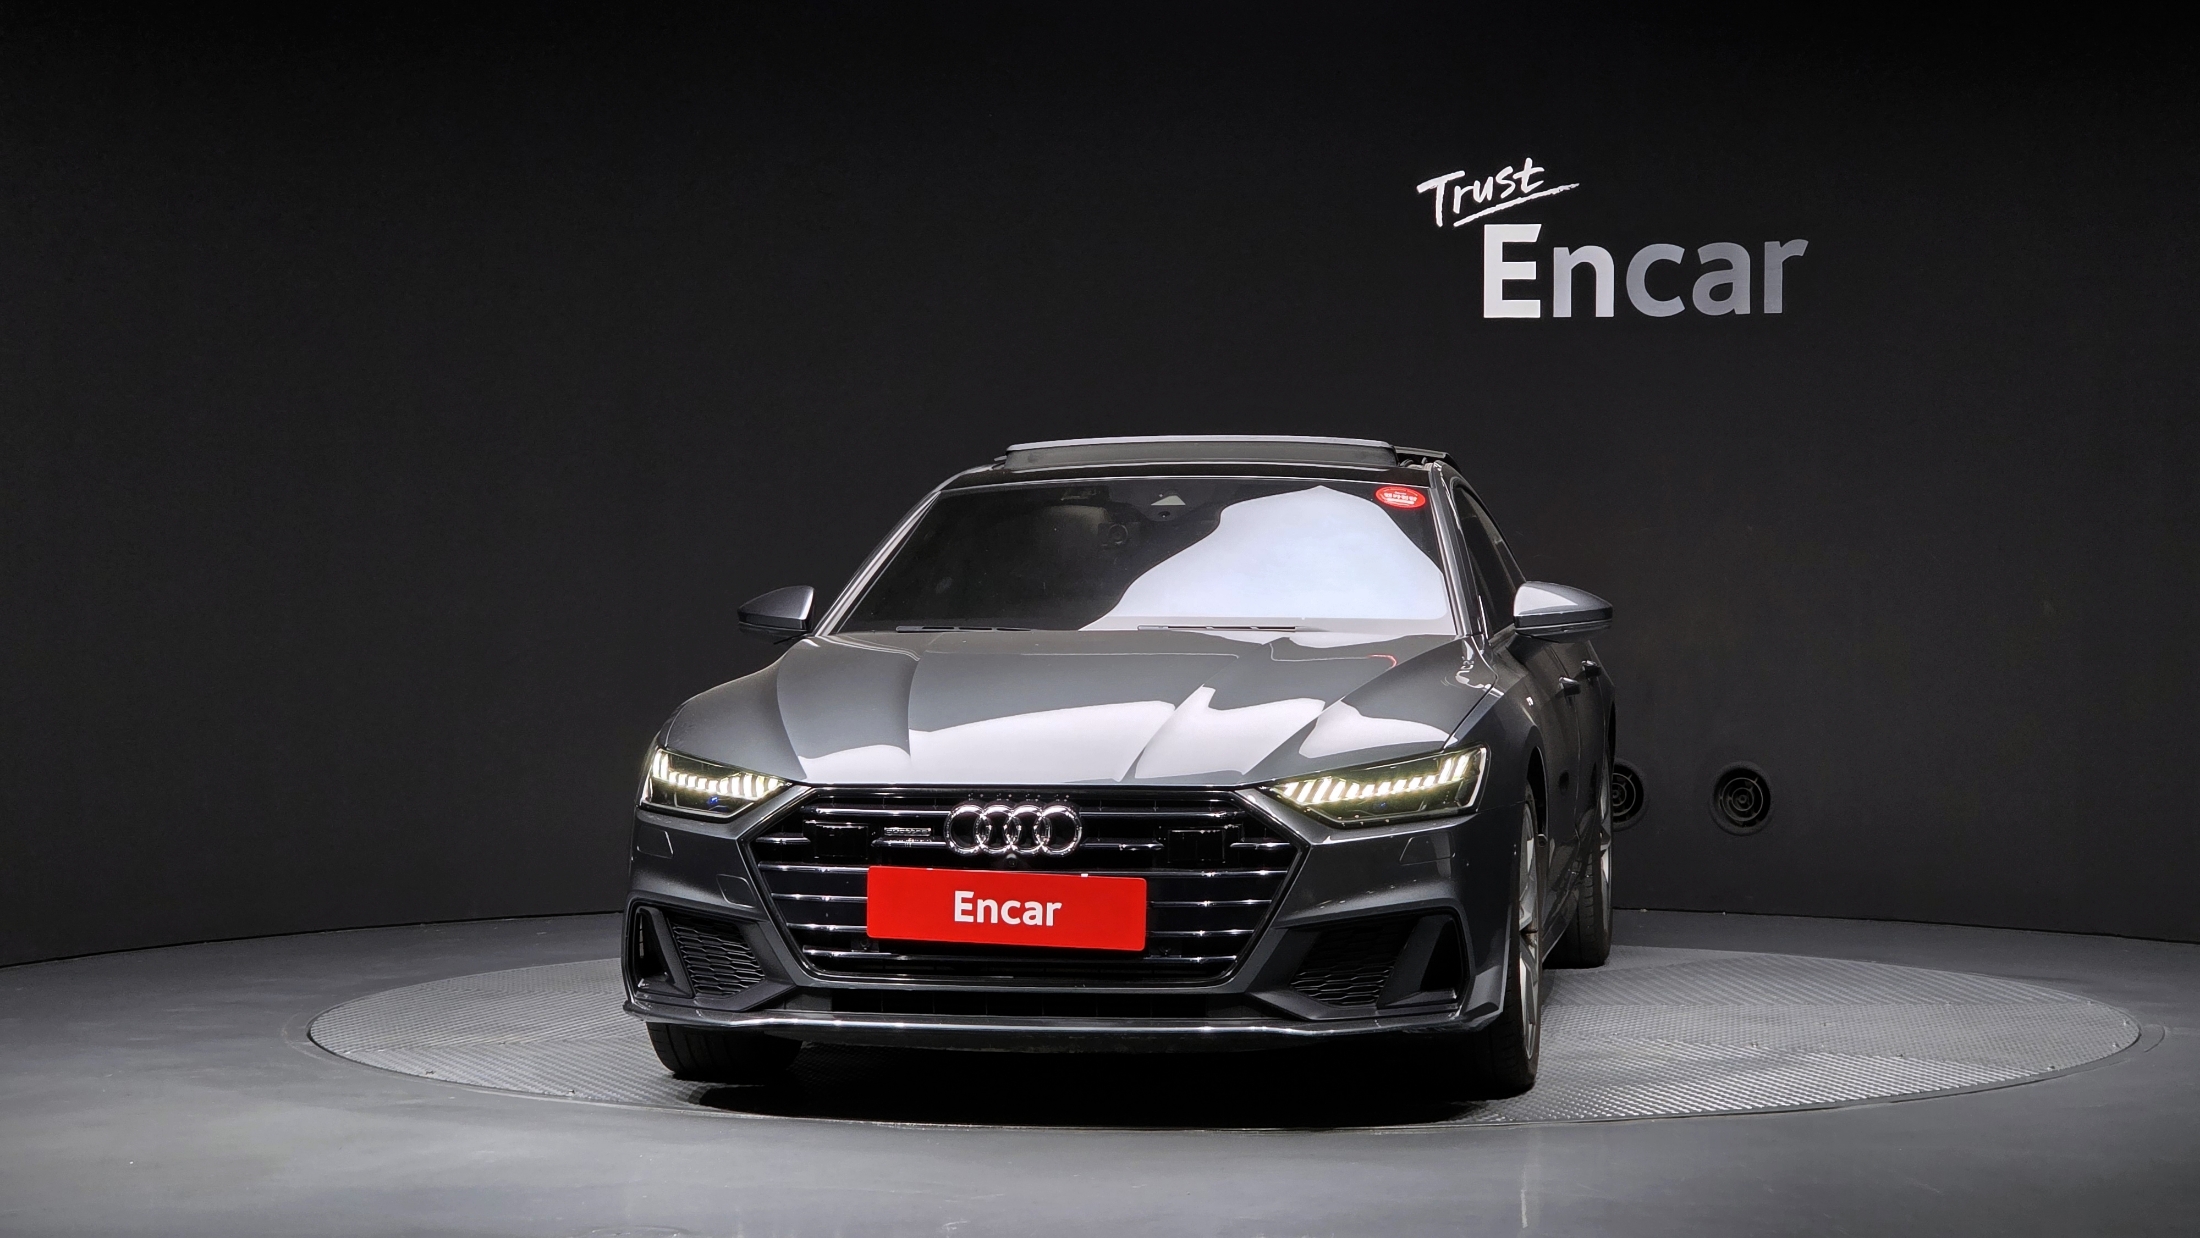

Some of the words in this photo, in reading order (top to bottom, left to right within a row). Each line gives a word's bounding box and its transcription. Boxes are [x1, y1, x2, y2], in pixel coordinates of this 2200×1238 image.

[1416, 157, 1546, 227] Trust
[1483, 223, 1809, 319] Encar
[954, 890, 1063, 927] Encar
